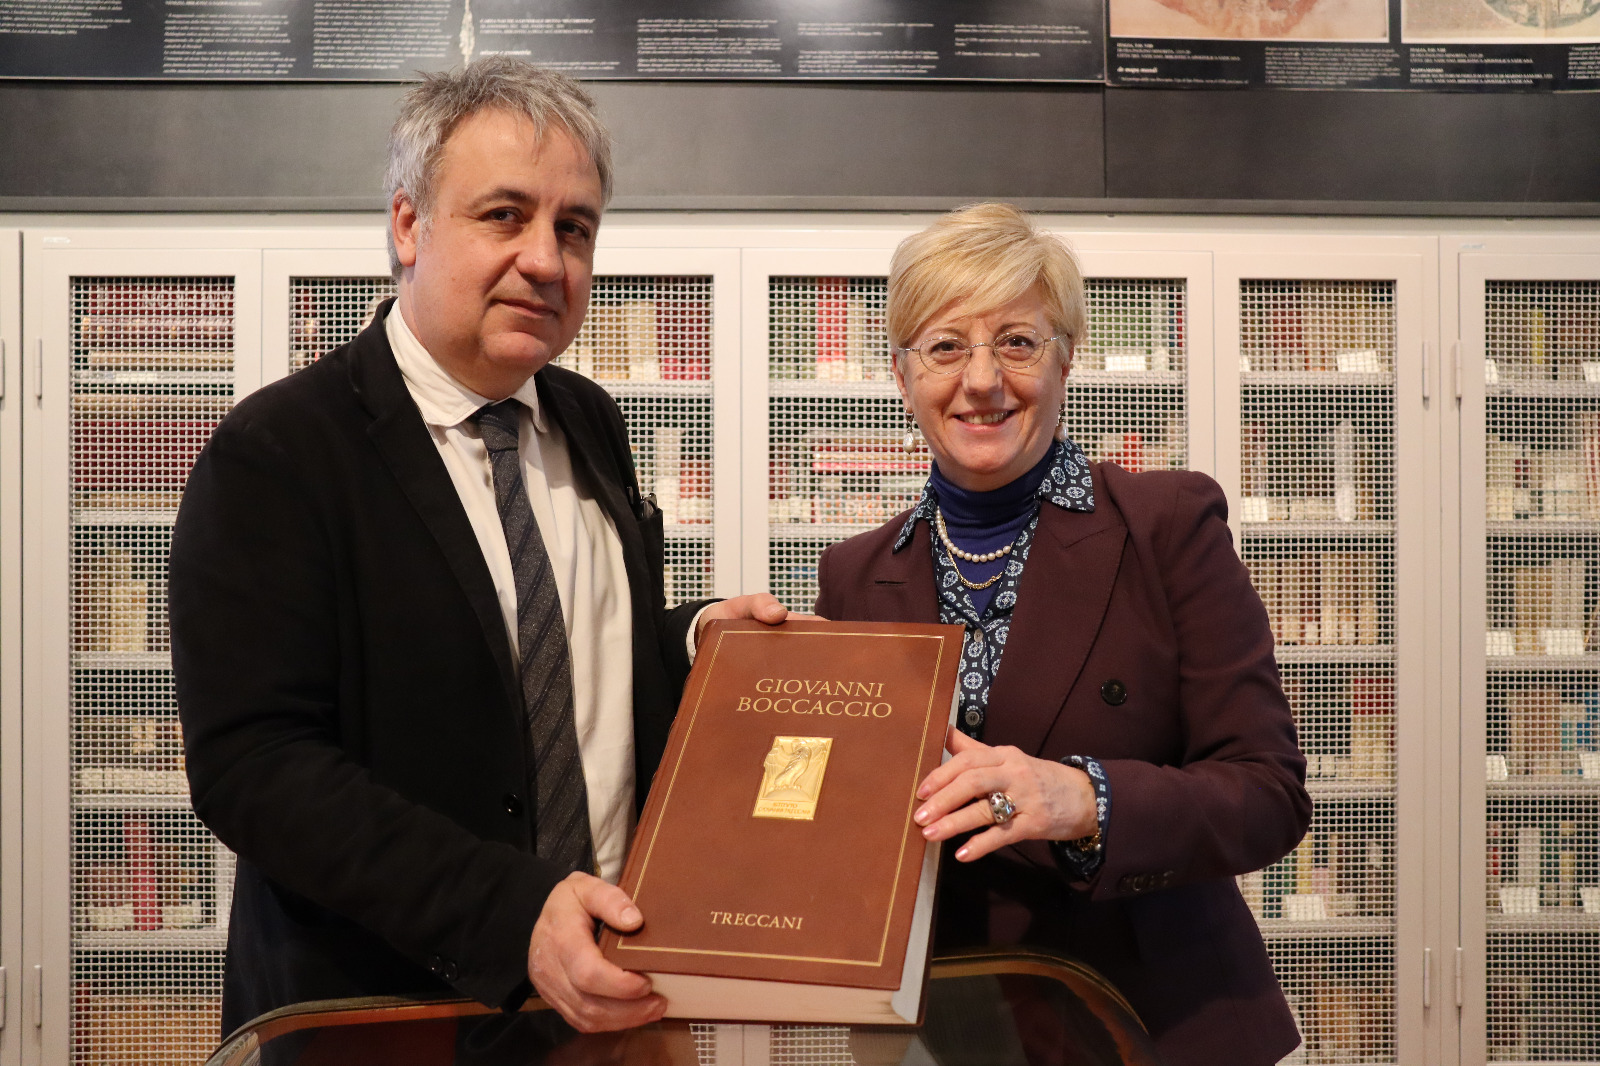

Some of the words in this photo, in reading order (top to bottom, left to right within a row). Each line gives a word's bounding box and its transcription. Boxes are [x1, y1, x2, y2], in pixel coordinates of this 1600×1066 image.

[755, 679, 884, 697] GIOVANNI
[736, 697, 892, 718] BOCCACCIO
[711, 911, 803, 930] TRECCANI
